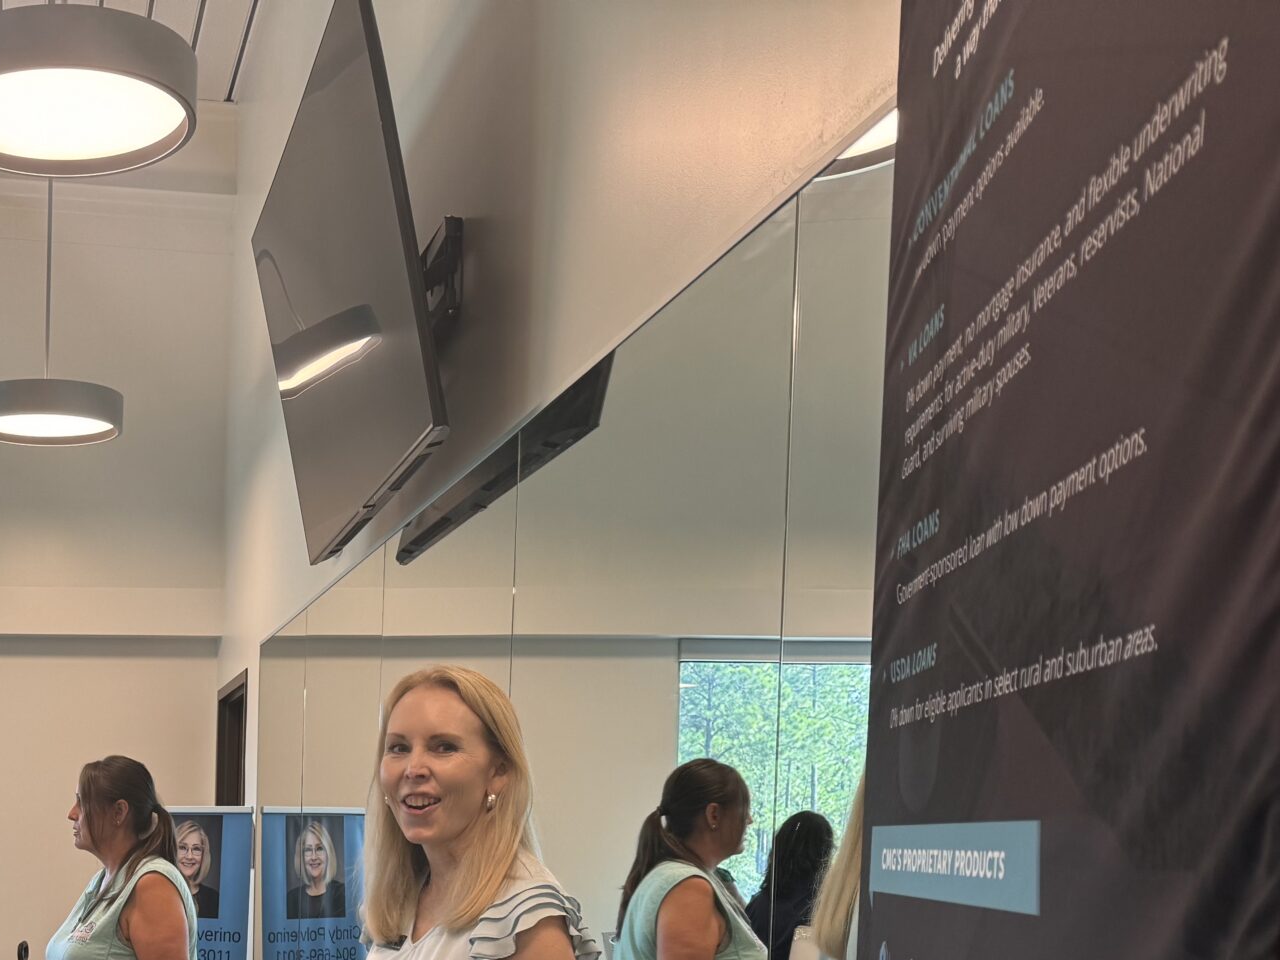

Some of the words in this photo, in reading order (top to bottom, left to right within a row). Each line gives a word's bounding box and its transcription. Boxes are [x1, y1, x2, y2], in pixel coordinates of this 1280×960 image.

[954, 54, 962, 80] a
[963, 17, 982, 66] way
[980, 68, 1015, 140] LOANS
[941, 185, 975, 250] payment
[976, 144, 1004, 200] options
[964, 321, 976, 347] no
[976, 276, 1014, 334] mortgage
[1015, 223, 1062, 291] insurance,
[1064, 187, 1087, 238] and
[1088, 144, 1131, 211] flexible
[1132, 36, 1229, 162] underwriting
[944, 380, 955, 405] for
[955, 335, 997, 396] active-duty
[1033, 252, 1078, 313] Veterans,
[1080, 187, 1141, 267] reservists,
[1144, 107, 1206, 202] National
[919, 302, 945, 353] LOANS
[922, 430, 935, 462] and
[965, 380, 996, 420] military
[968, 531, 986, 562] loan
[986, 515, 1004, 549] with
[1003, 507, 1020, 538] low
[1020, 490, 1048, 527] down
[1049, 456, 1098, 518] payment
[1098, 427, 1148, 485] options.
[897, 530, 911, 559] FHA
[912, 508, 940, 549] LOANS
[890, 656, 911, 684] USDA
[912, 642, 938, 676] LOANS
[898, 703, 915, 727] down
[914, 698, 924, 721] for
[924, 688, 947, 724] eligible
[947, 678, 984, 718] applicants
[984, 674, 993, 701] in
[993, 666, 1020, 697] select
[1020, 654, 1043, 689] rural
[1043, 647, 1065, 683] and
[1065, 634, 1123, 677] suburban
[1123, 623, 1158, 661] areas.
[881, 847, 902, 871] CMG'S
[902, 848, 954, 875] PROPRIETARY
[954, 849, 1006, 880] PRODUCTS
[197, 926, 241, 943] verino
